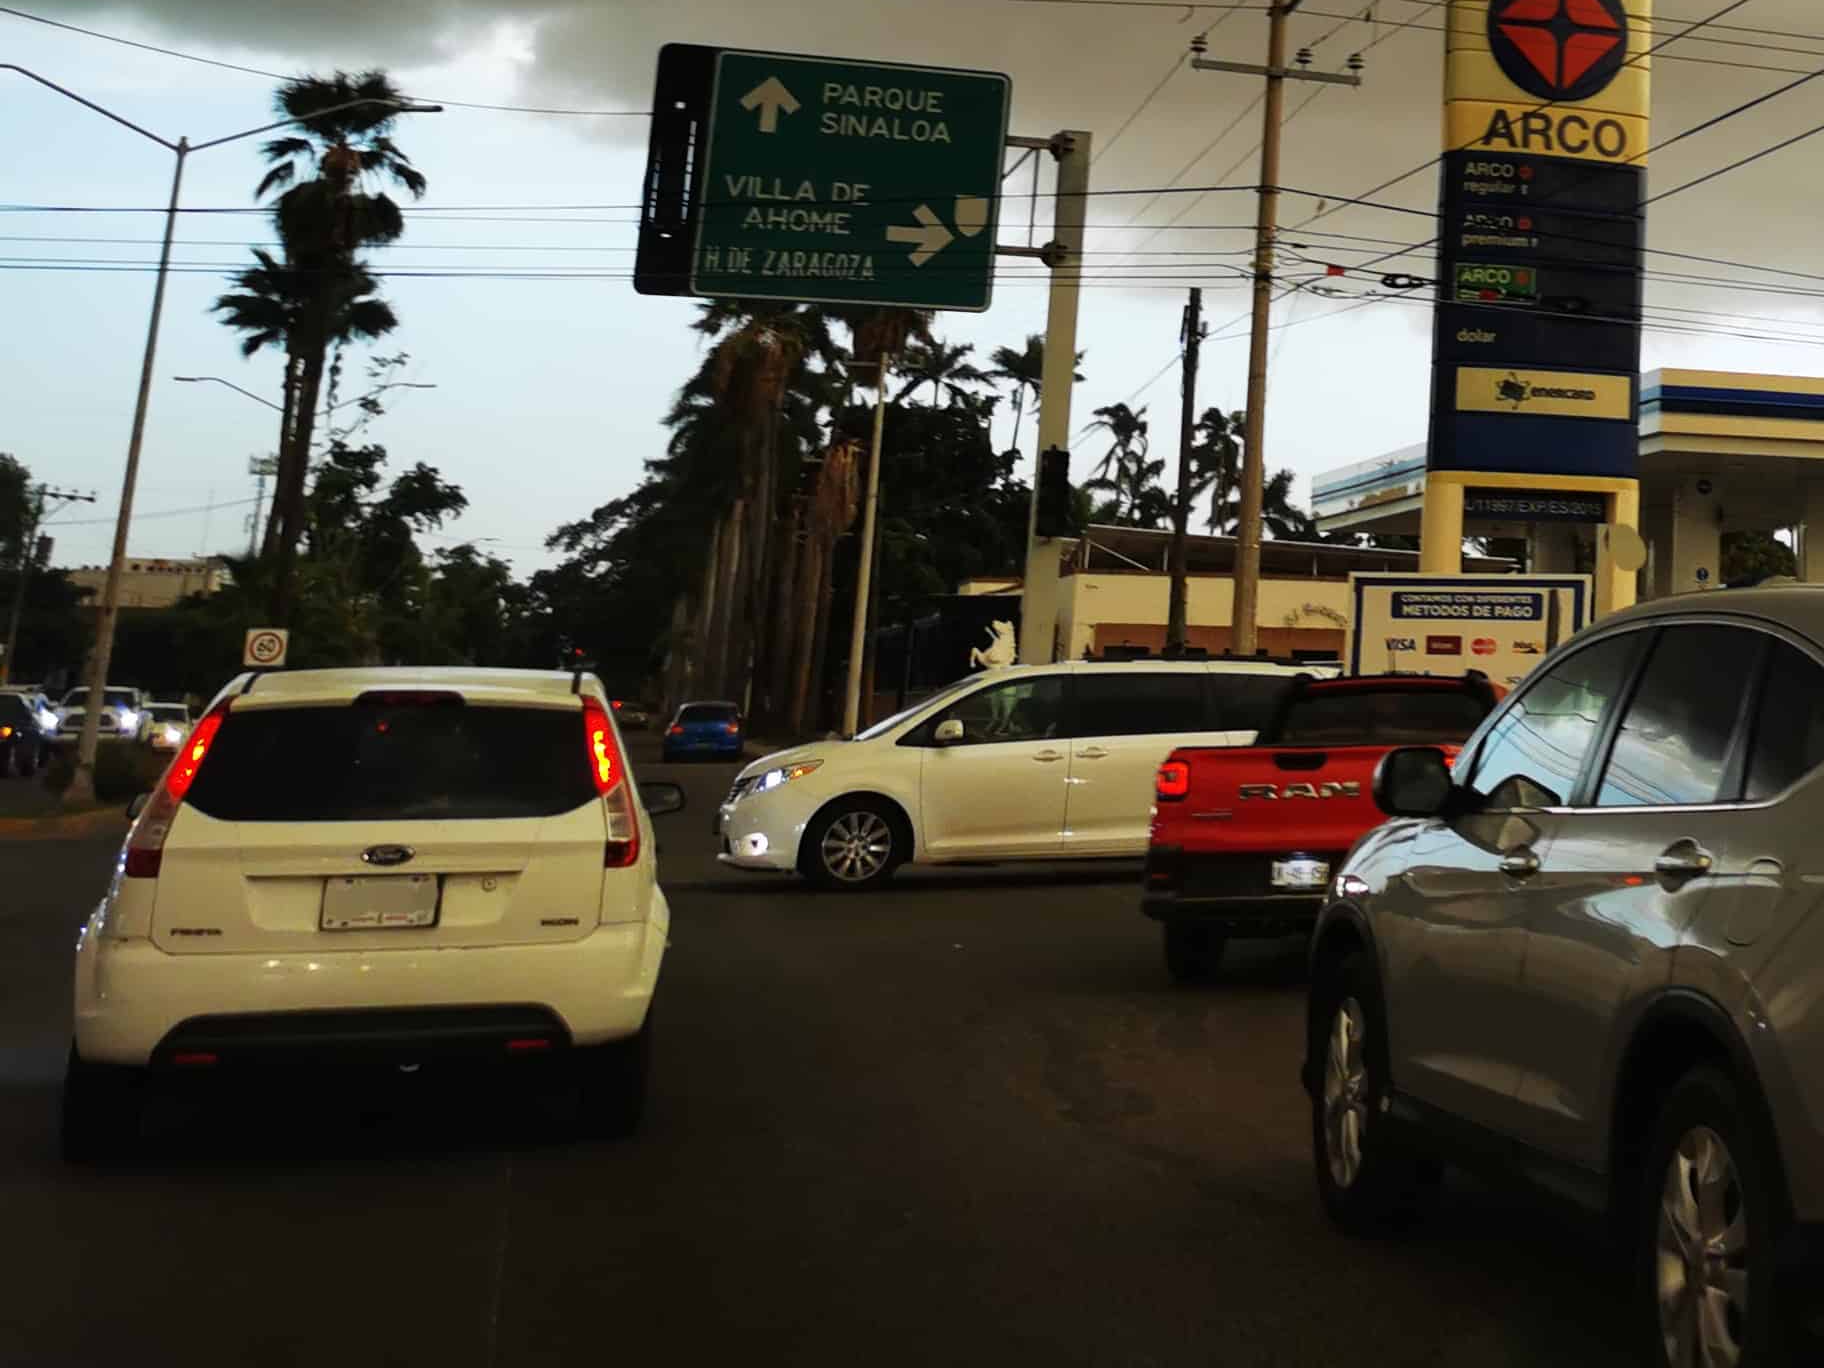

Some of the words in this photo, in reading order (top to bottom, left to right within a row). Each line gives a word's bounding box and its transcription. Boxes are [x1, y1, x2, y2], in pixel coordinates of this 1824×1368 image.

[822, 82, 945, 113] PARQUE
[820, 112, 951, 143] SINALOA
[1480, 109, 1627, 157] ARCO
[1464, 161, 1515, 178] ARCO
[725, 174, 816, 202] VILLA
[832, 181, 871, 206] DE
[742, 206, 851, 234] AHOME
[728, 246, 753, 274] DE
[761, 249, 876, 281] ZARAGOZA
[1460, 267, 1511, 284] ARCO
[1402, 604, 1469, 617] METODOS
[1472, 605, 1493, 618] DE
[1495, 606, 1534, 619] PAGO
[1386, 638, 1416, 651] VISA
[1239, 781, 1361, 801] RAM
